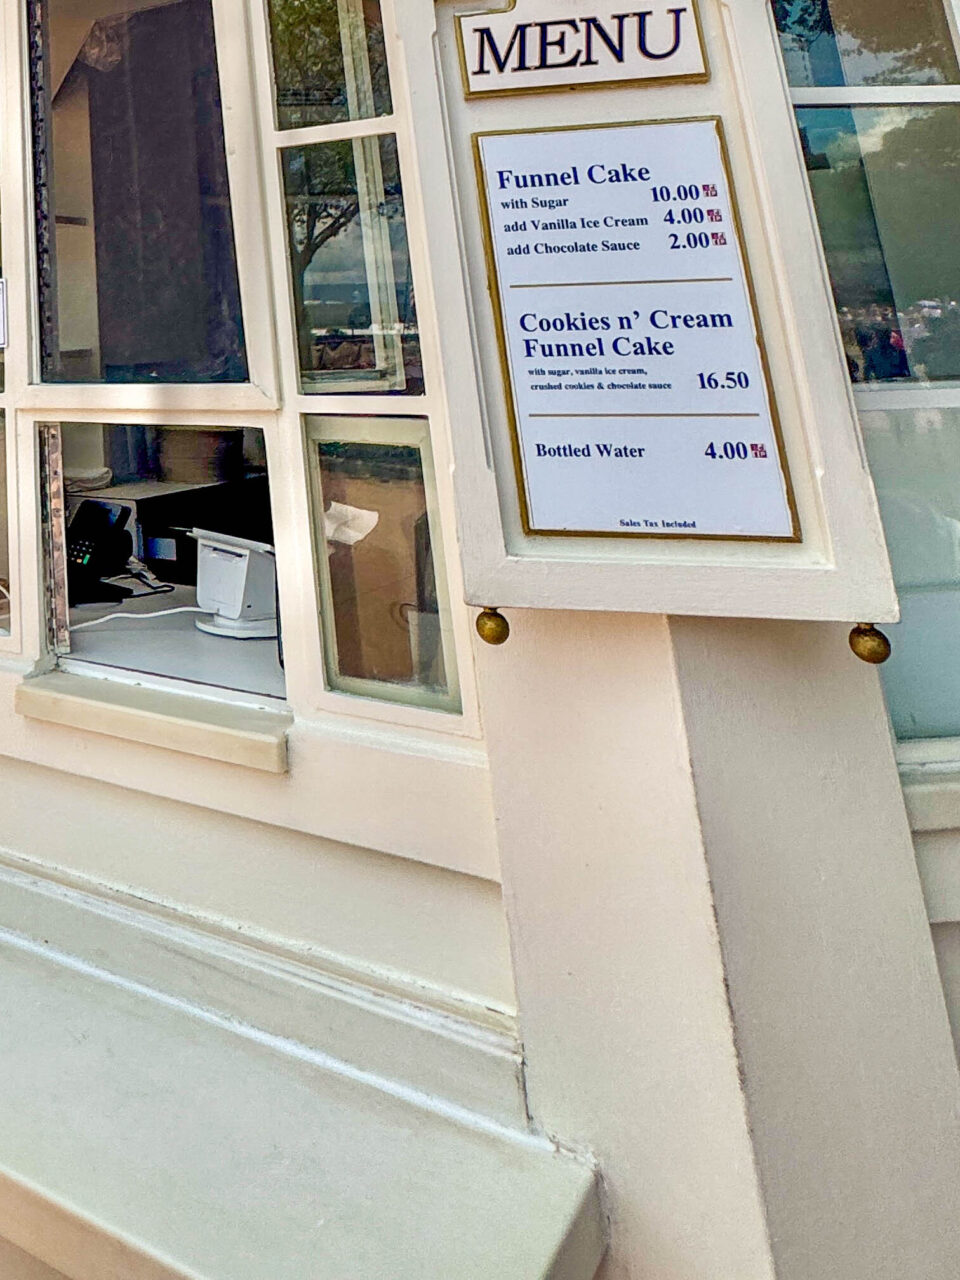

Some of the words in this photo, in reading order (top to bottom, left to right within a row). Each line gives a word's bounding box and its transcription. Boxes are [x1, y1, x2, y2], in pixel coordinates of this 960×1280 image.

[472, 8, 687, 75] MENU
[496, 167, 580, 189] Funnel
[587, 163, 651, 184] Cake
[650, 184, 700, 202] 10.00
[500, 198, 528, 210] with
[531, 197, 569, 211] Sugar
[504, 221, 527, 232] add
[531, 219, 577, 231] Vanilla
[581, 218, 600, 229] Ice
[603, 216, 649, 228] Cream
[663, 207, 704, 225] 4.00
[507, 244, 530, 255] add
[533, 242, 598, 254] Chocolate
[602, 240, 640, 252] Sauce
[668, 232, 710, 250] 2.00
[520, 312, 611, 332] Cookies
[650, 310, 733, 330] Cream
[522, 338, 605, 358] Funnel
[612, 336, 675, 356] Cake
[528, 368, 546, 376] with
[547, 368, 574, 378] sugar,
[575, 367, 603, 376] vanilla
[604, 367, 617, 375] ice
[618, 367, 648, 377] cream,
[697, 371, 749, 390] 16.50
[530, 382, 563, 391] crushed
[564, 381, 595, 390] cookies
[596, 382, 605, 390] &
[607, 381, 646, 390] chocolate
[535, 443, 590, 458] Bottled
[595, 443, 645, 458] Water
[704, 441, 748, 460] 4.00
[619, 519, 641, 527] Sales
[644, 519, 658, 528] Tax
[661, 520, 696, 529] Included
